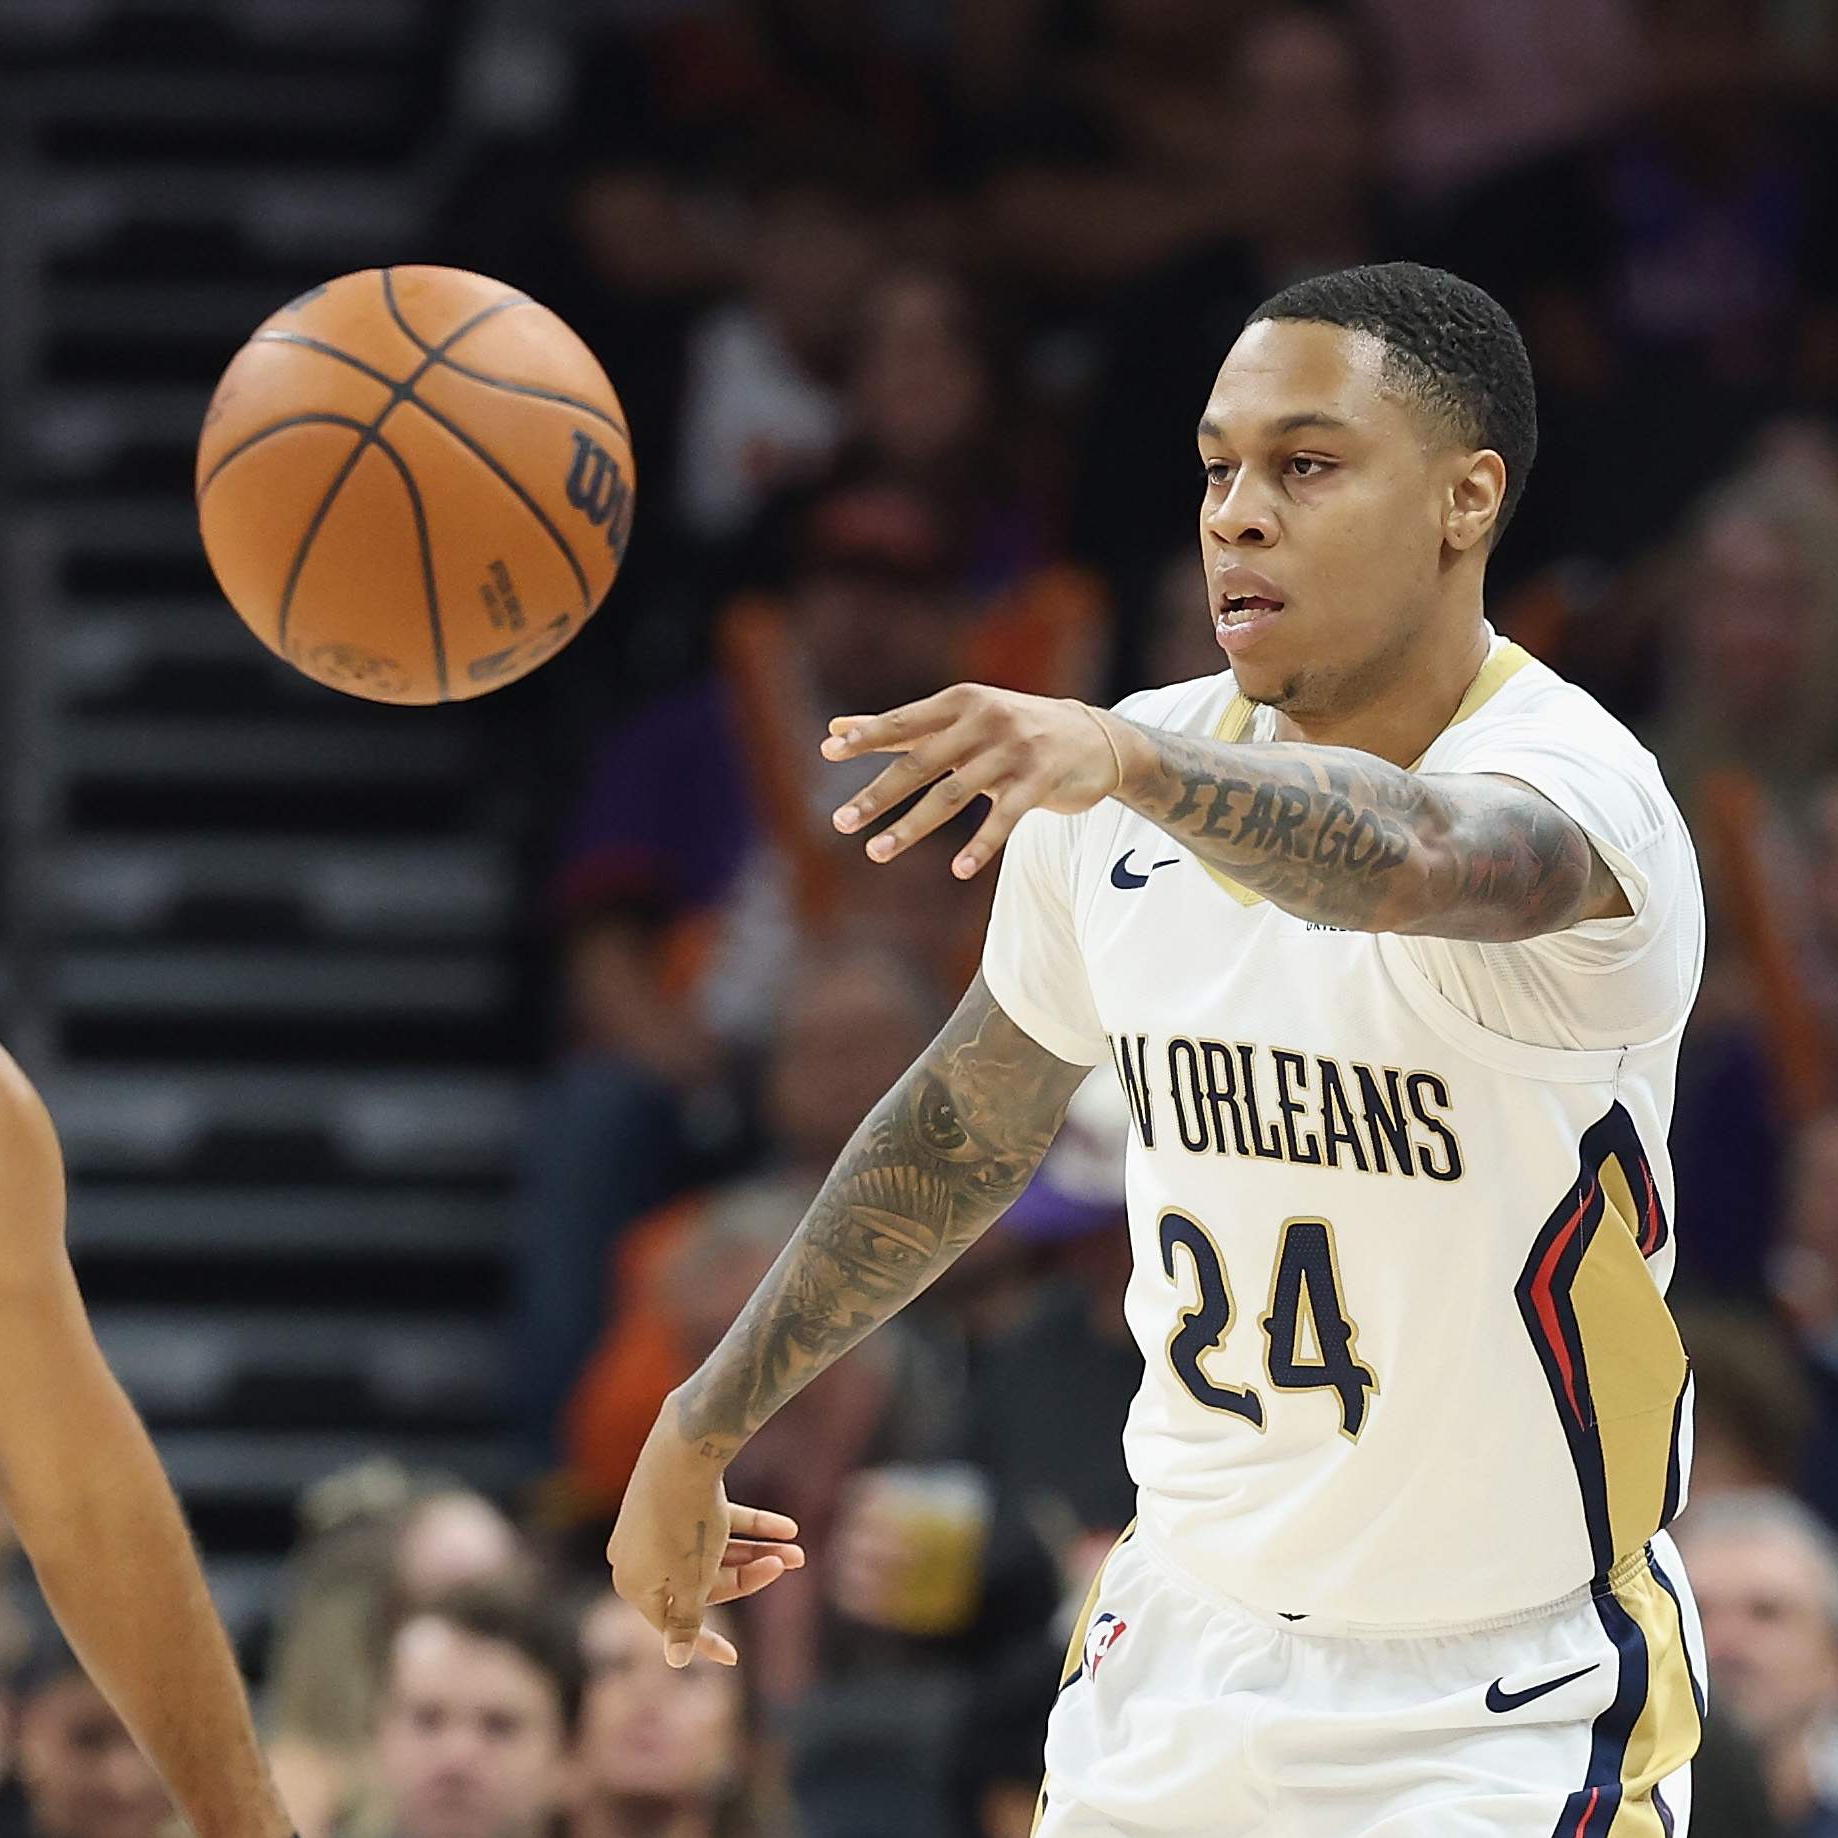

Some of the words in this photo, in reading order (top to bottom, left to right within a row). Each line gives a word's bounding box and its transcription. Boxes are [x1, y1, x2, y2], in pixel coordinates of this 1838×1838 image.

[1164, 774, 1311, 855] FEAR
[1311, 798, 1411, 873] GOD
[1166, 1034, 1465, 1183] ORLEANS
[1157, 1204, 1381, 1445] 24
